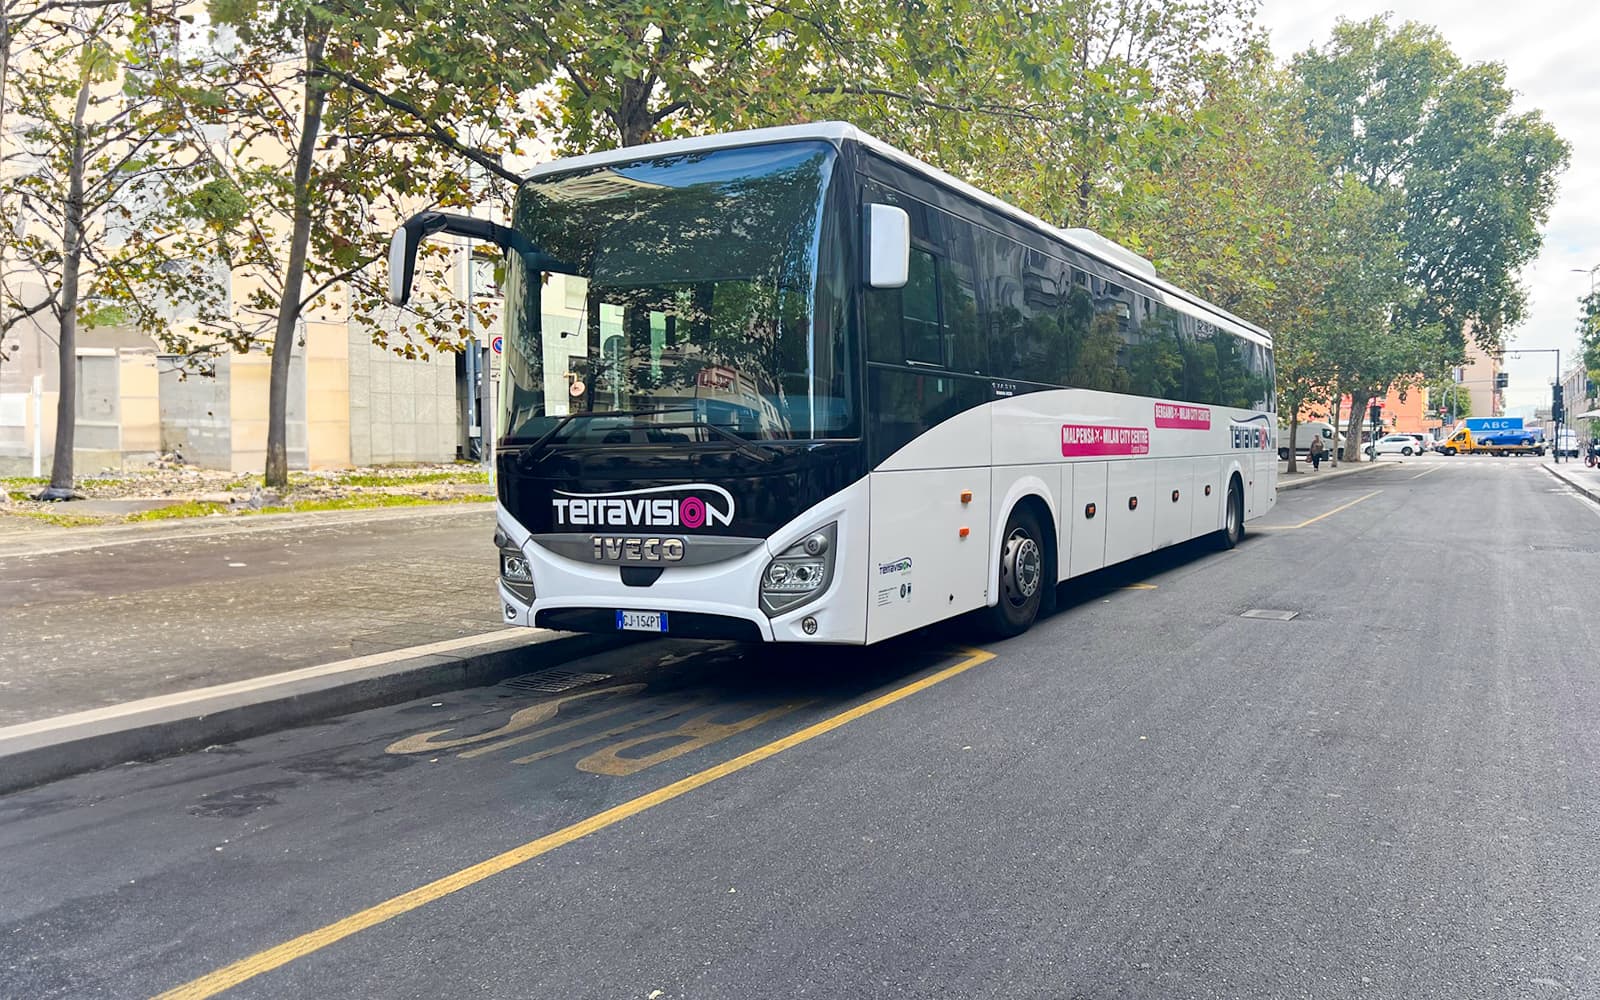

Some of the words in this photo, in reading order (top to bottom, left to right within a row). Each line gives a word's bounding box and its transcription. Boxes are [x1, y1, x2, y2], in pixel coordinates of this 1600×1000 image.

[1481, 421, 1509, 429] ABC
[1063, 427, 1095, 444] MALPENSA
[1103, 428, 1119, 444] MILAN
[1120, 429, 1130, 444] CITY
[1131, 429, 1148, 444] CENTRE
[594, 536, 684, 561] IVECO
